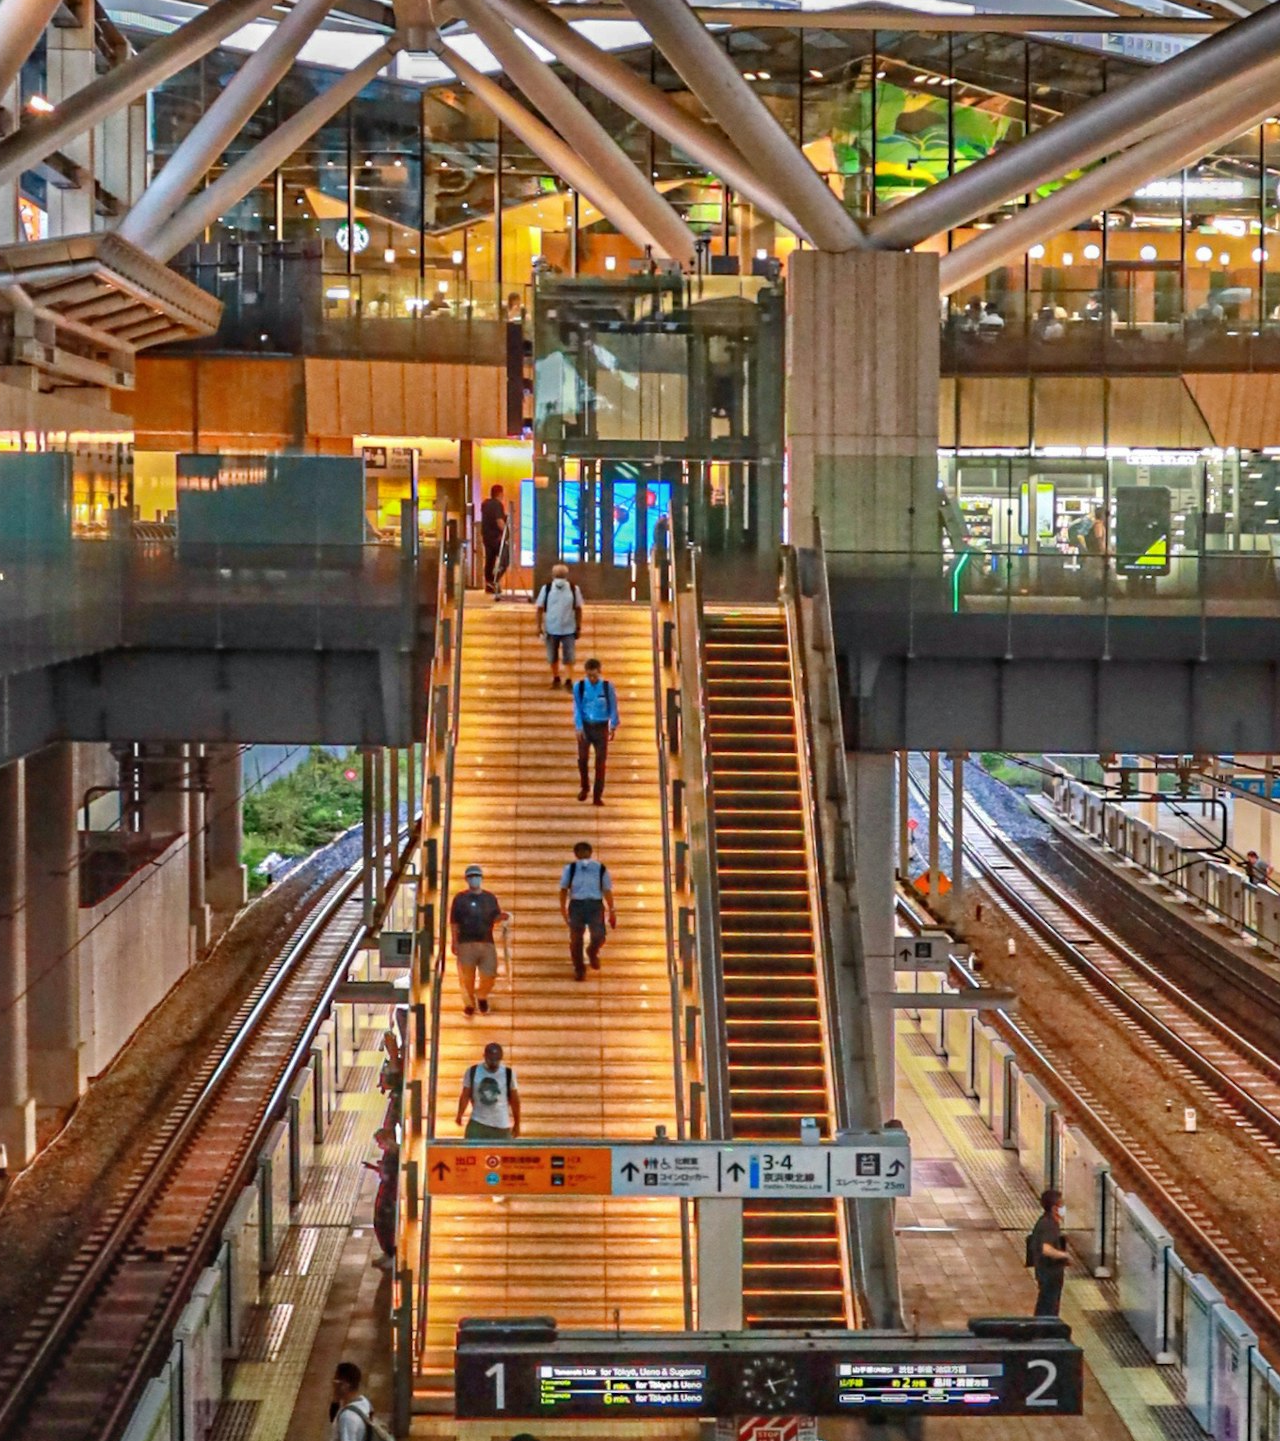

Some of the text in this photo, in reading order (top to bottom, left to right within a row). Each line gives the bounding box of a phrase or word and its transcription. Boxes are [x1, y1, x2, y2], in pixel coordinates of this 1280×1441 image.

[455, 1156, 476, 1166] 出口
[763, 1173, 815, 1183] 京浜東北線
[884, 1181, 905, 1190] 25m
[600, 1367, 612, 1376] for
[640, 1367, 661, 1376] Ueno
[661, 1368, 668, 1376] &
[669, 1367, 702, 1377] Sugamo
[485, 1362, 505, 1410] 1
[604, 1380, 611, 1390] 1
[635, 1381, 647, 1389] for
[672, 1381, 680, 1389] &
[680, 1381, 702, 1389] Ueno
[1025, 1359, 1058, 1406] 2
[603, 1392, 613, 1404] 6
[635, 1394, 647, 1402] for
[672, 1394, 680, 1402] &
[680, 1394, 702, 1402] Ueno
